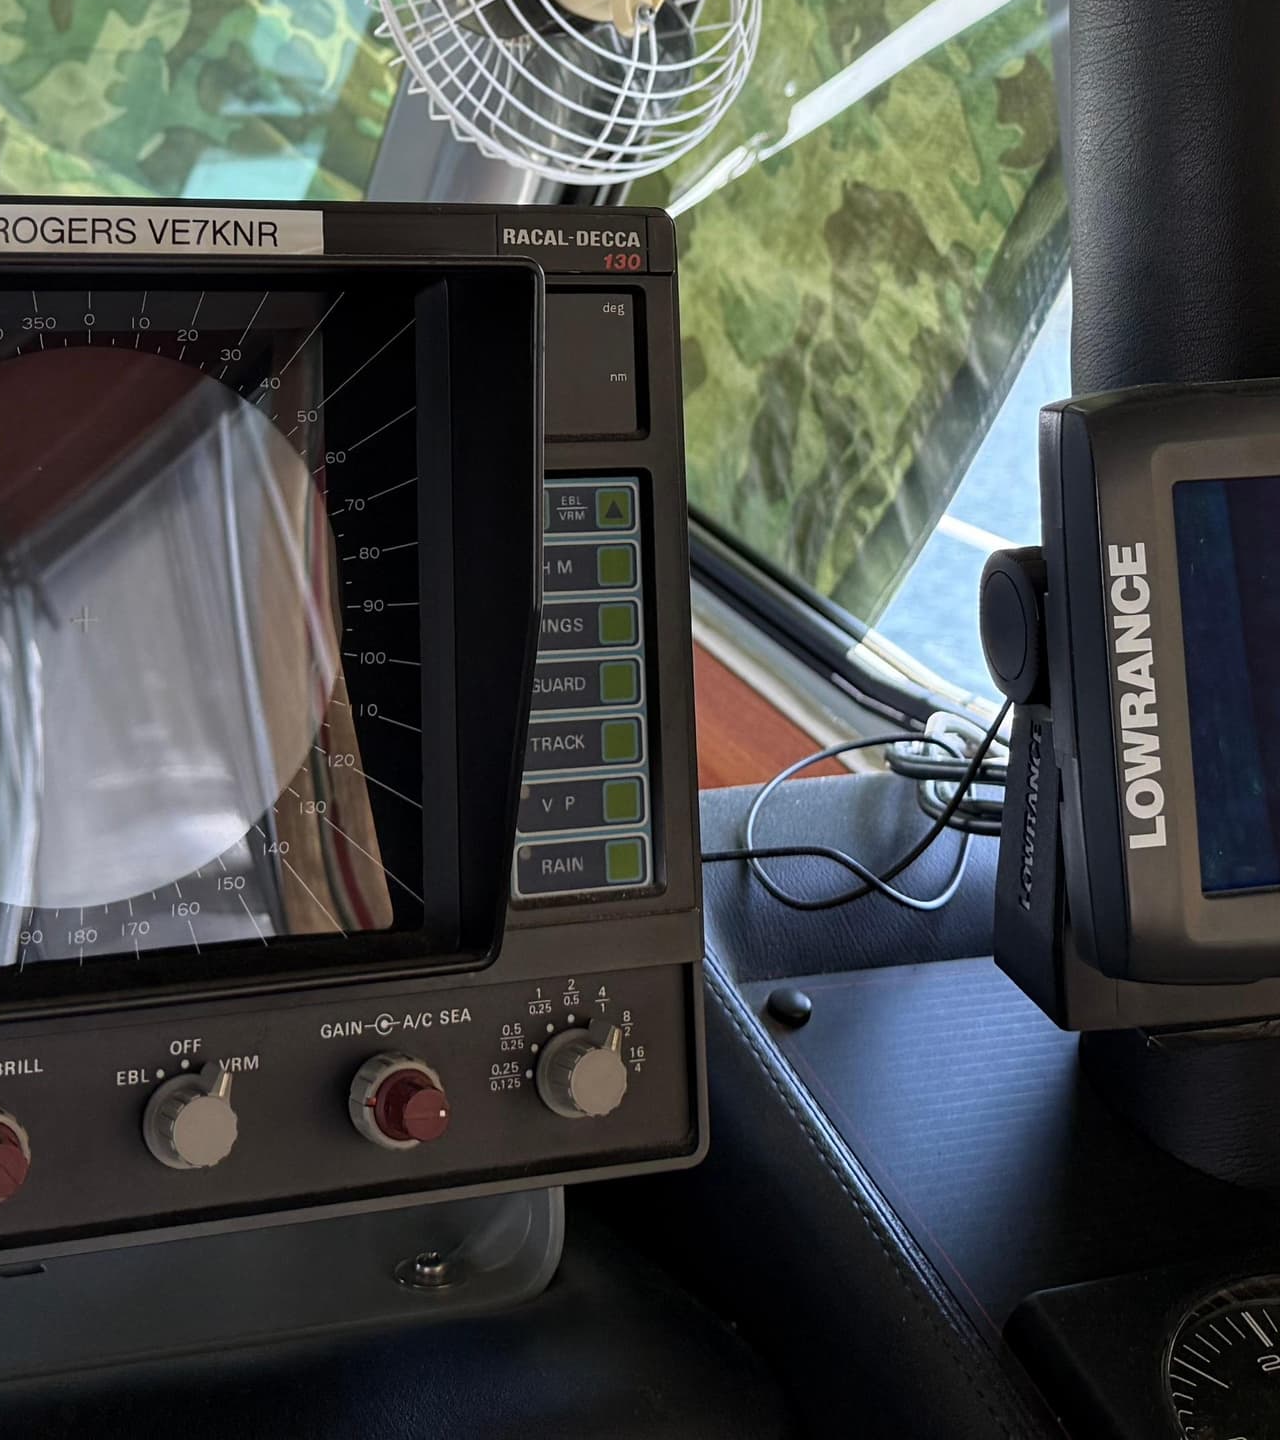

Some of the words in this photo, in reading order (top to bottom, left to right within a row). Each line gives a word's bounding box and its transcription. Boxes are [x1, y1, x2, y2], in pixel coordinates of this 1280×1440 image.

[148, 218, 279, 248] VE7KNR
[503, 228, 642, 248] RACAL-DECCA
[603, 253, 642, 271] 130
[602, 302, 625, 317] deg
[22, 317, 57, 330] 350
[131, 316, 151, 329] 10
[177, 329, 199, 342] 20
[220, 348, 242, 362] 30
[259, 377, 281, 390] 40
[609, 372, 628, 383] nm
[297, 410, 319, 423] 50
[325, 451, 347, 464] 60
[344, 498, 366, 512] 70
[560, 495, 583, 507] EBL
[558, 510, 586, 522] VRM
[358, 546, 380, 560] 80
[557, 560, 573, 575] M
[362, 598, 385, 613] 90
[541, 617, 585, 634] INGS
[359, 651, 387, 666] 100
[531, 676, 587, 694] GUARD
[1108, 542, 1167, 849] LOWRANCE
[531, 735, 586, 753] TRACK
[328, 753, 356, 768] 120
[299, 800, 328, 815] 130
[541, 798, 554, 814] V
[564, 795, 577, 811] P
[263, 840, 291, 856] 140
[541, 856, 585, 875] RAIN
[217, 875, 247, 891] 150
[171, 901, 202, 918] 160
[121, 920, 151, 937] 170
[17, 929, 44, 945] 90
[68, 929, 99, 946] 180
[563, 994, 580, 1007] 0.5
[528, 1003, 552, 1016] 0.25
[403, 1012, 433, 1030] A/C
[439, 1007, 472, 1025] SEA
[320, 1020, 363, 1039] GAIN
[502, 1023, 522, 1036] 0.5
[170, 1038, 202, 1056] OFF
[500, 1039, 524, 1052] 0.25
[219, 1054, 260, 1072] VRM
[491, 1062, 520, 1076] 0.25
[116, 1068, 150, 1086] EBL
[490, 1078, 521, 1092] 0.125
